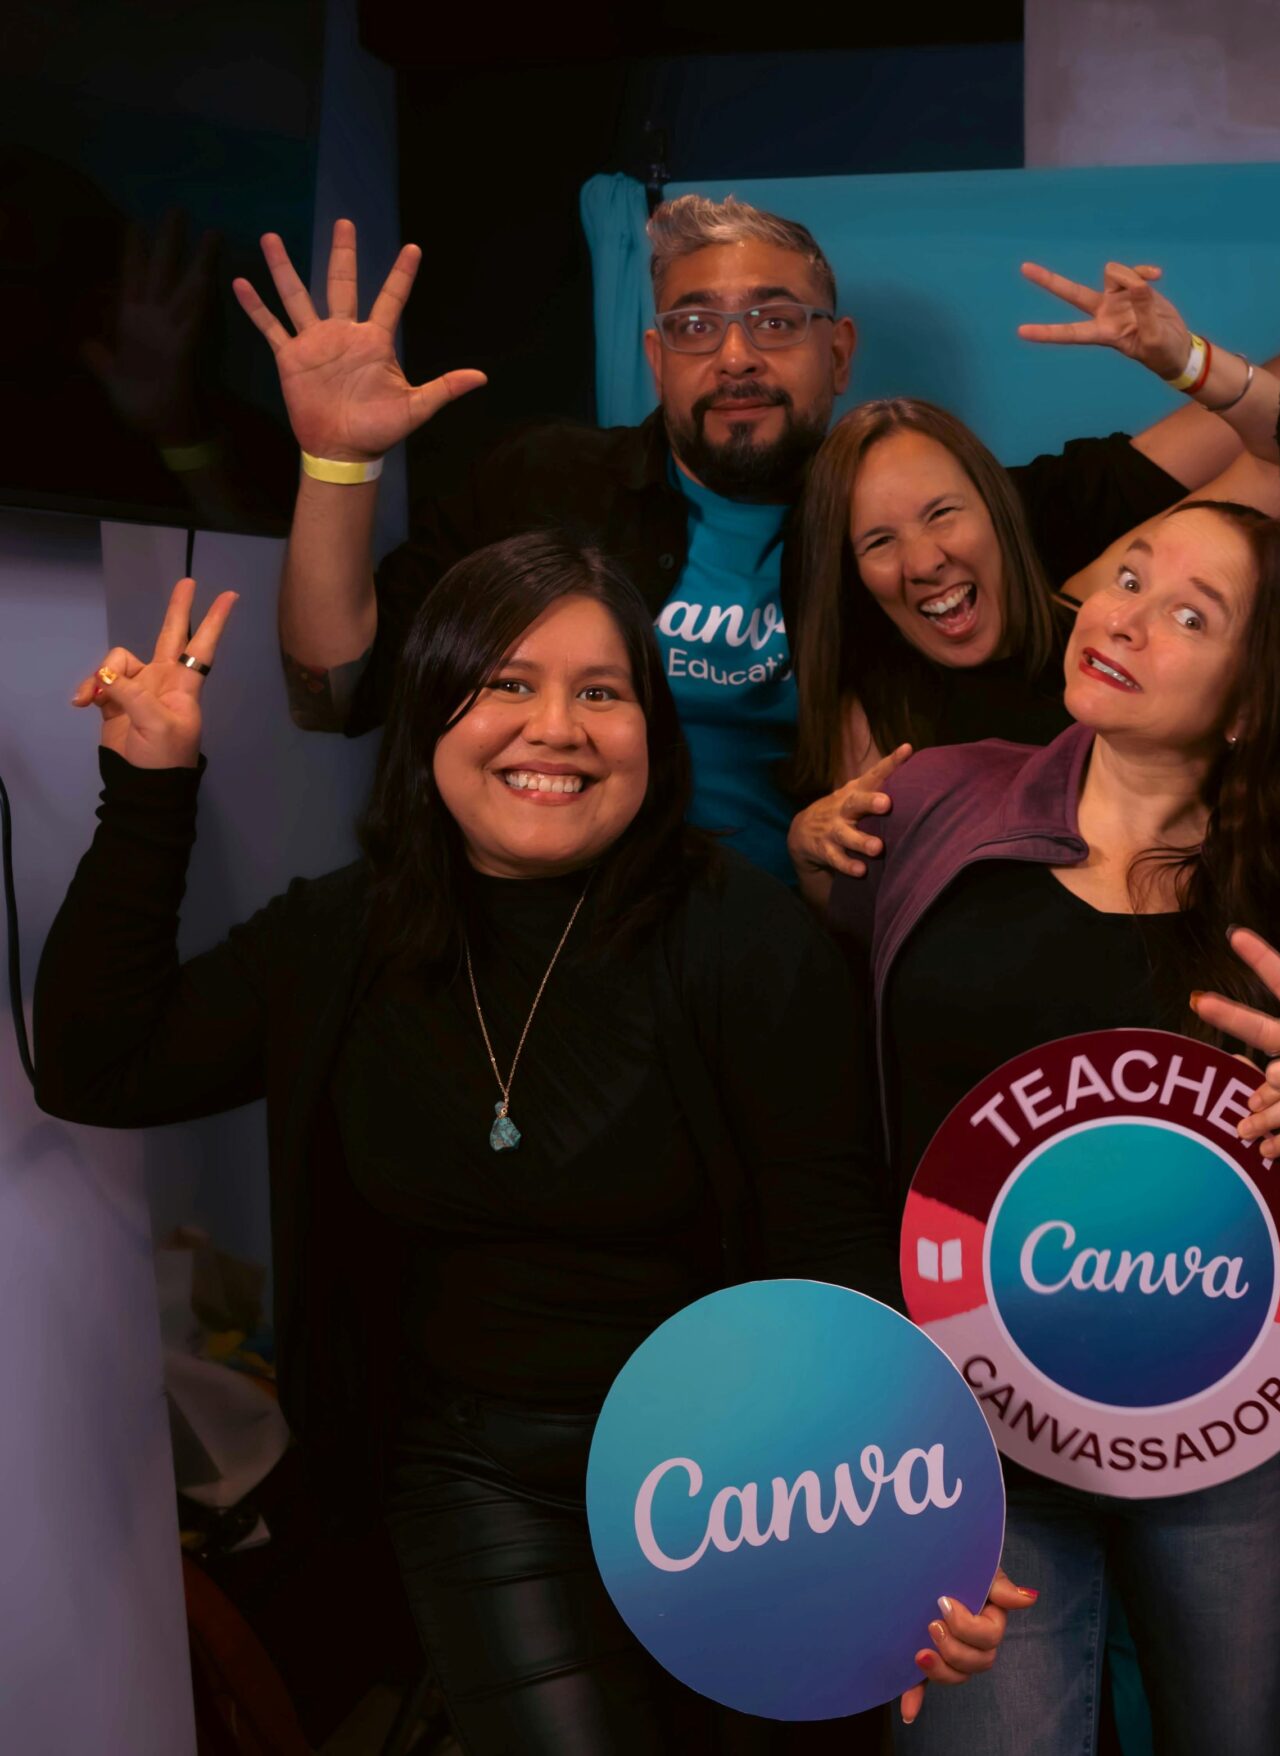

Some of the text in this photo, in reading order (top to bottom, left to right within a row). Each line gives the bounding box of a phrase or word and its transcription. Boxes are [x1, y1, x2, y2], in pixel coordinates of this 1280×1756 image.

[653, 601, 786, 650] anv
[668, 647, 792, 685] Educat
[970, 1050, 1273, 1172] TEACHE
[1019, 1219, 1249, 1300] Canva
[634, 1443, 963, 1572] Canva
